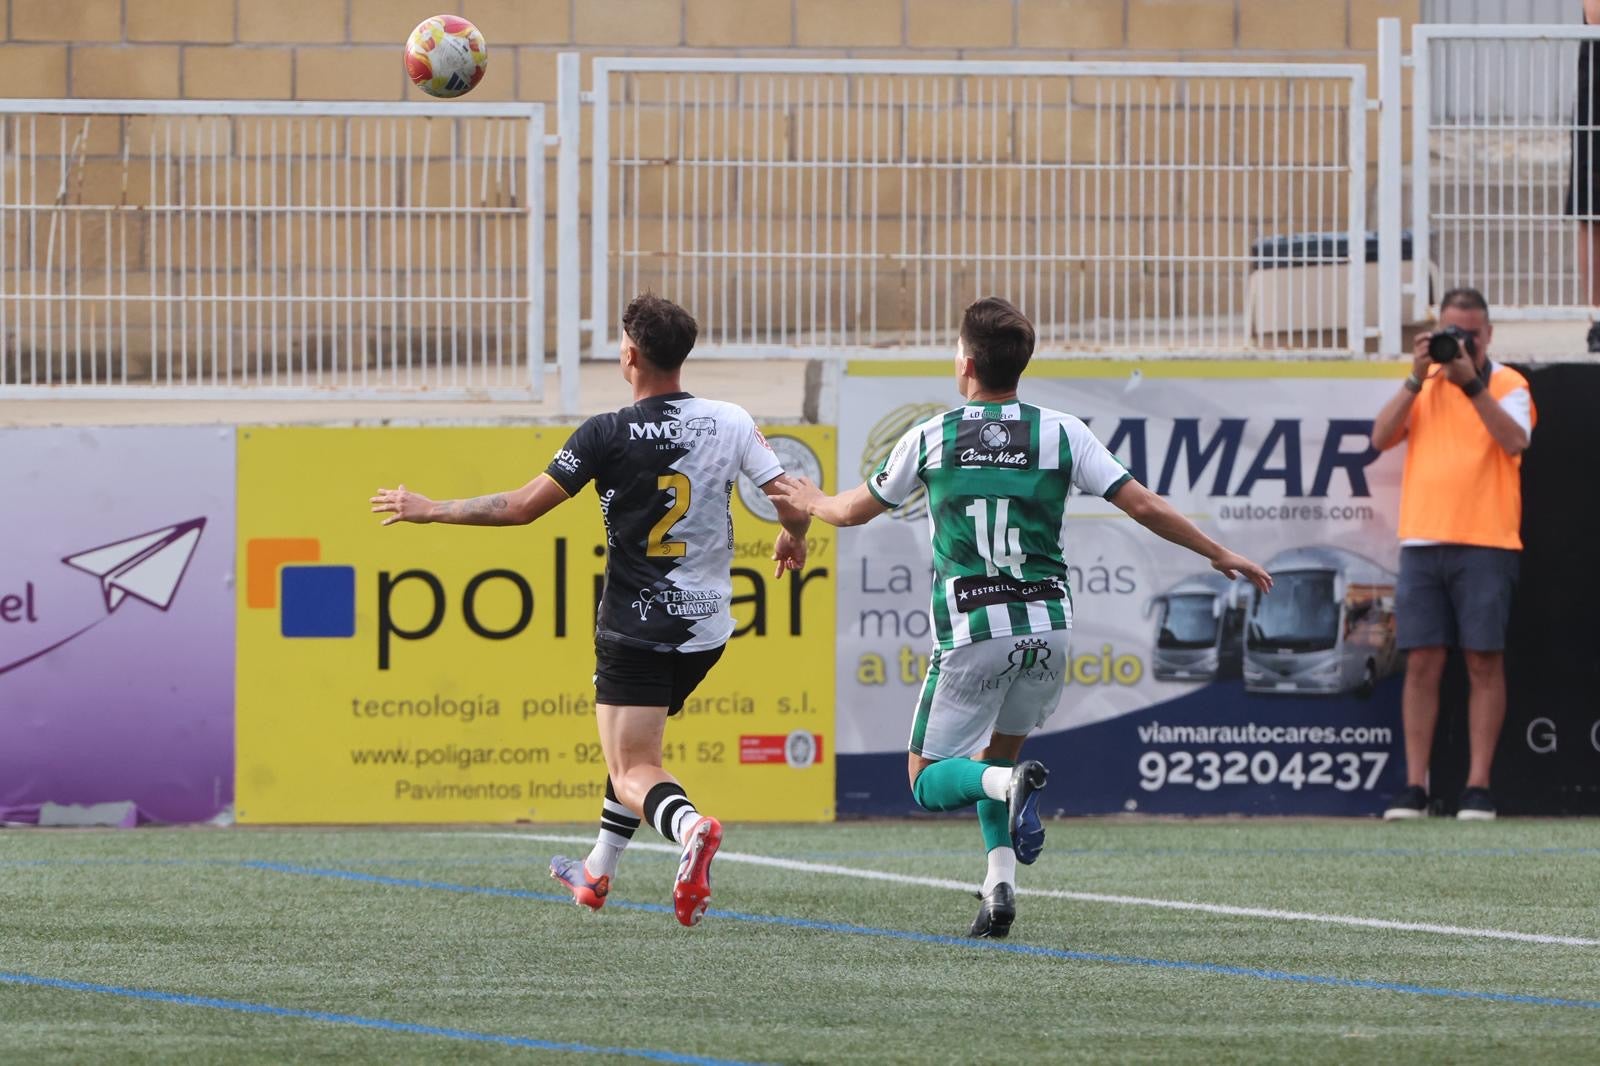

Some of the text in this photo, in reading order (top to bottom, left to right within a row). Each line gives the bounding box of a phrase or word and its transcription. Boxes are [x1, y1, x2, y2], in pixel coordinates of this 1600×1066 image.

[628, 420, 682, 440] MMG
[994, 451, 1028, 465] Nieto
[646, 472, 691, 557] 2
[1219, 503, 1374, 520] autocares.com
[966, 498, 1027, 578] 14
[861, 556, 912, 594] La
[378, 536, 829, 671] poliar
[660, 590, 722, 603] TERNERA
[666, 601, 720, 616] CHARRA
[857, 653, 885, 685] a
[352, 695, 500, 721] tecnología
[1138, 721, 1392, 744] viamarautocares.com
[351, 744, 549, 769] www.poligar.com
[697, 741, 725, 763] 52
[1138, 750, 1390, 791] 923204237
[395, 780, 604, 800] Pavimentos Industr
